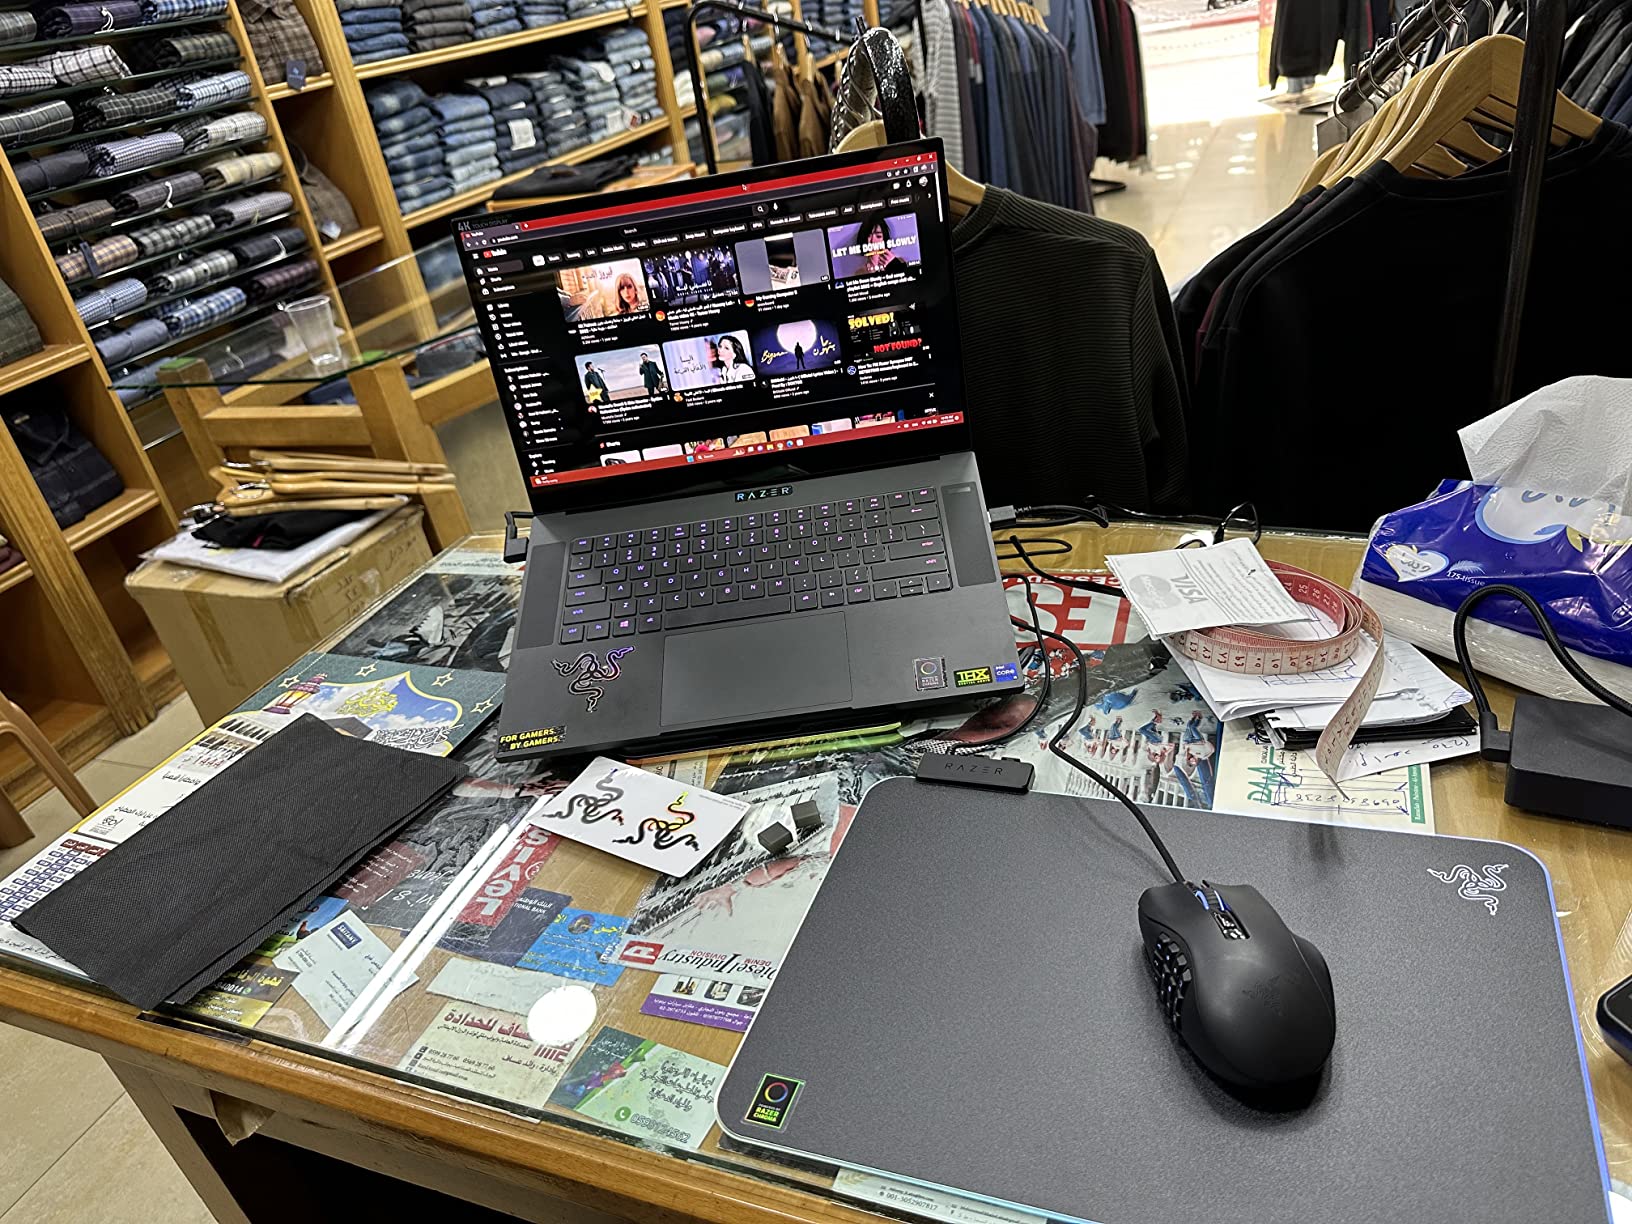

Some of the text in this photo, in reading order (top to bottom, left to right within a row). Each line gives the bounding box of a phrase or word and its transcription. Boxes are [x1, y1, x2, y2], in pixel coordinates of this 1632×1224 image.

[458, 221, 471, 231] 4K
[832, 235, 917, 258] LET ME DOWN SLOWLY
[848, 312, 895, 329] SOLVED!
[873, 338, 922, 353] NOT FOUND?
[737, 487, 789, 501] RAZER
[1171, 575, 1208, 604] VISA
[956, 668, 990, 682] THX
[500, 734, 517, 744] FOR
[509, 742, 521, 750] BY
[944, 762, 1003, 775] RAZER
[690, 950, 772, 967] DENIM DIVISION
[443, 1005, 498, 1034] للحدادة
[753, 1112, 777, 1122] CHROMA
[755, 1106, 780, 1117] RAZER
